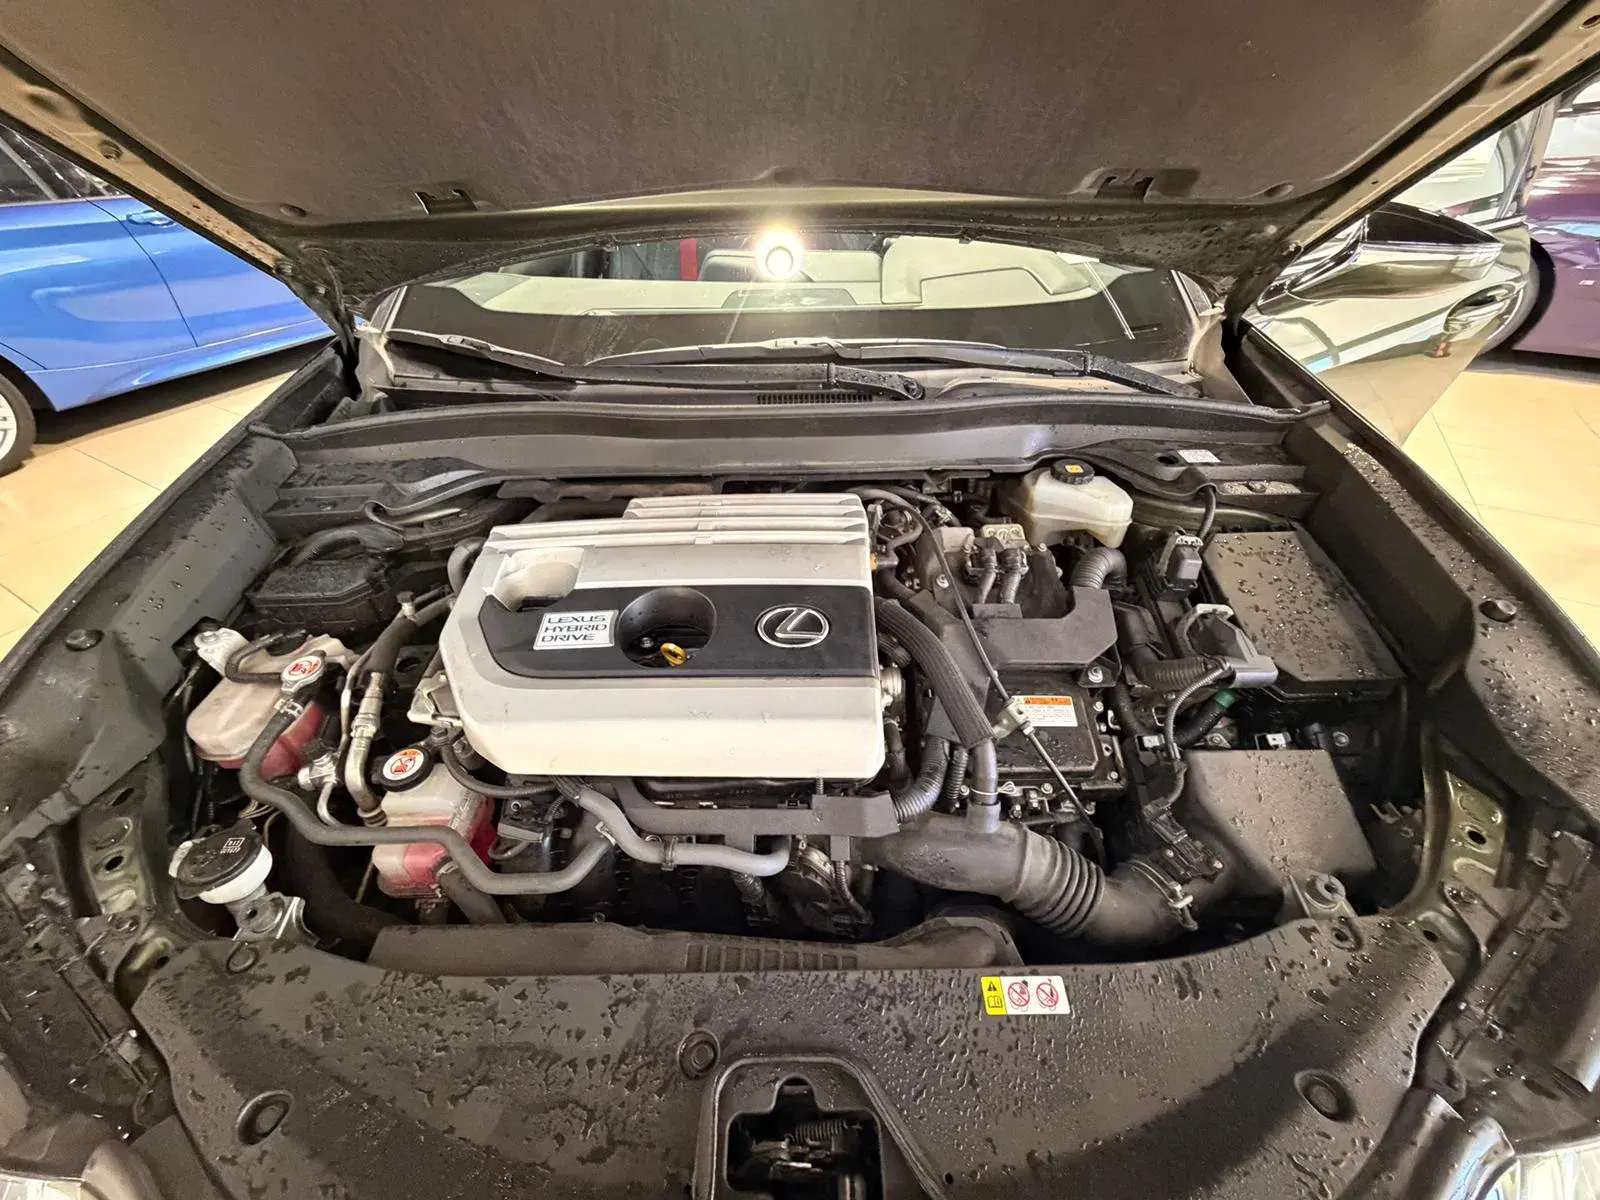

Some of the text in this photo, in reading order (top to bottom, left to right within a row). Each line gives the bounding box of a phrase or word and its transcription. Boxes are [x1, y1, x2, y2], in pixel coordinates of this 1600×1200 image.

[547, 615, 606, 624] LEXUS
[544, 623, 608, 633] HYBRID
[541, 633, 598, 643] DRIVE
